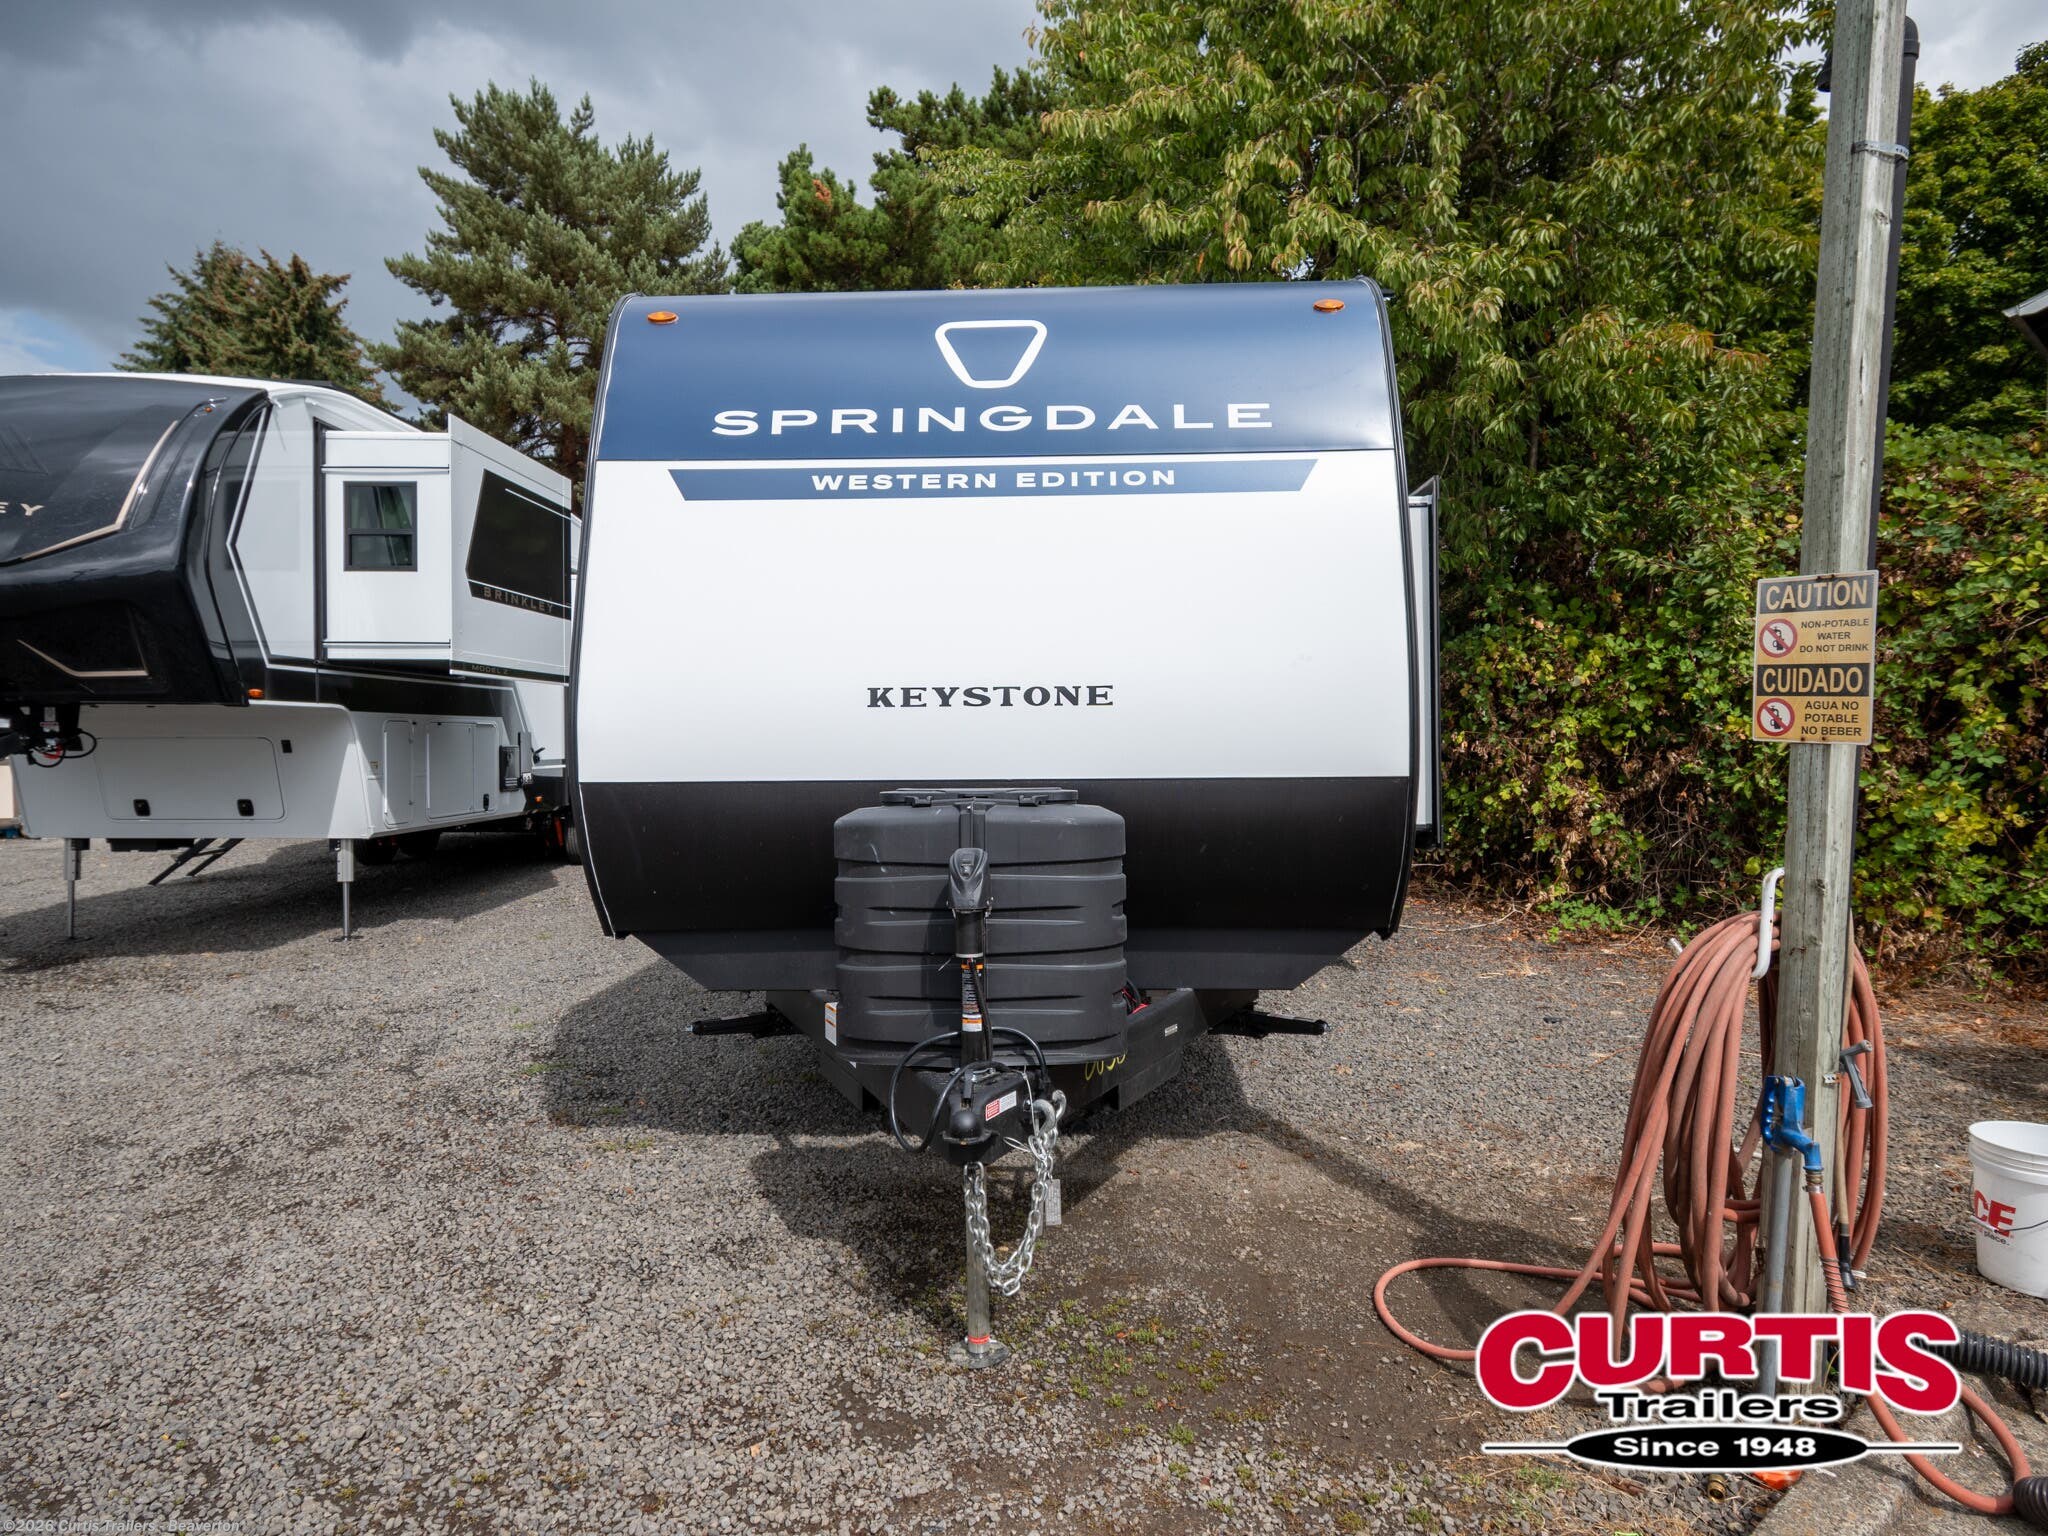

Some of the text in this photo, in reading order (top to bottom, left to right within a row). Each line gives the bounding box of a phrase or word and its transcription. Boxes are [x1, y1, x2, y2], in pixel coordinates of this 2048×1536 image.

[711, 403, 1274, 436] SPRINGDALE
[811, 469, 1176, 491] WESTERN EDITION
[483, 586, 553, 614] BRINKLEY
[1765, 579, 1868, 611] CAUTION
[1800, 618, 1869, 629] NON-POTABLE
[1817, 631, 1851, 641] WATER
[1800, 643, 1869, 653] DO NOT DRINK
[471, 664, 501, 674] MODEL
[1762, 667, 1864, 693] CUIDADO
[866, 685, 1114, 708] KEYSTONE
[1804, 700, 1859, 710] AGUA NO
[1804, 713, 1859, 723] POTABLE
[1801, 726, 1862, 737] NO BEBER
